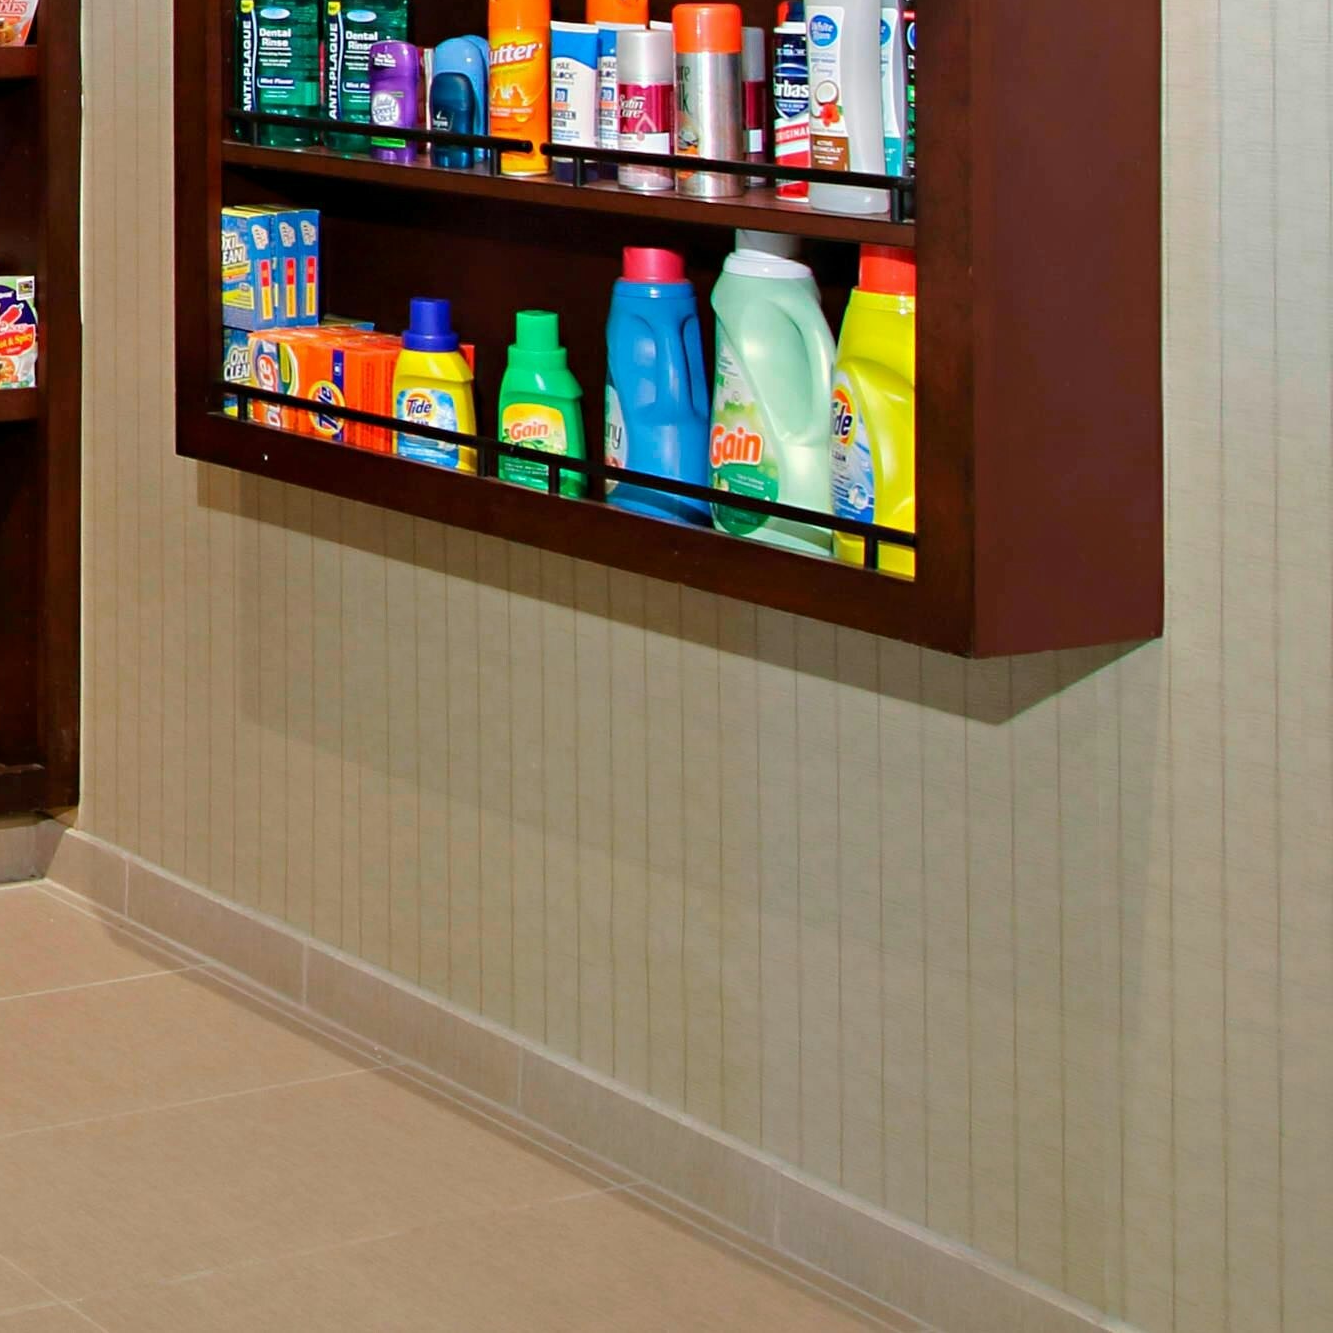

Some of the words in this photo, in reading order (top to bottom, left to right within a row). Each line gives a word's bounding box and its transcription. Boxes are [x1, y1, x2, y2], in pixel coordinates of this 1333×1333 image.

[259, 28, 292, 38] Dental
[345, 31, 378, 42] Dental
[261, 37, 289, 48] Rinse
[488, 42, 537, 66] utter
[407, 398, 433, 416] Tide
[510, 420, 549, 441] Gain
[710, 424, 764, 467] Gain
